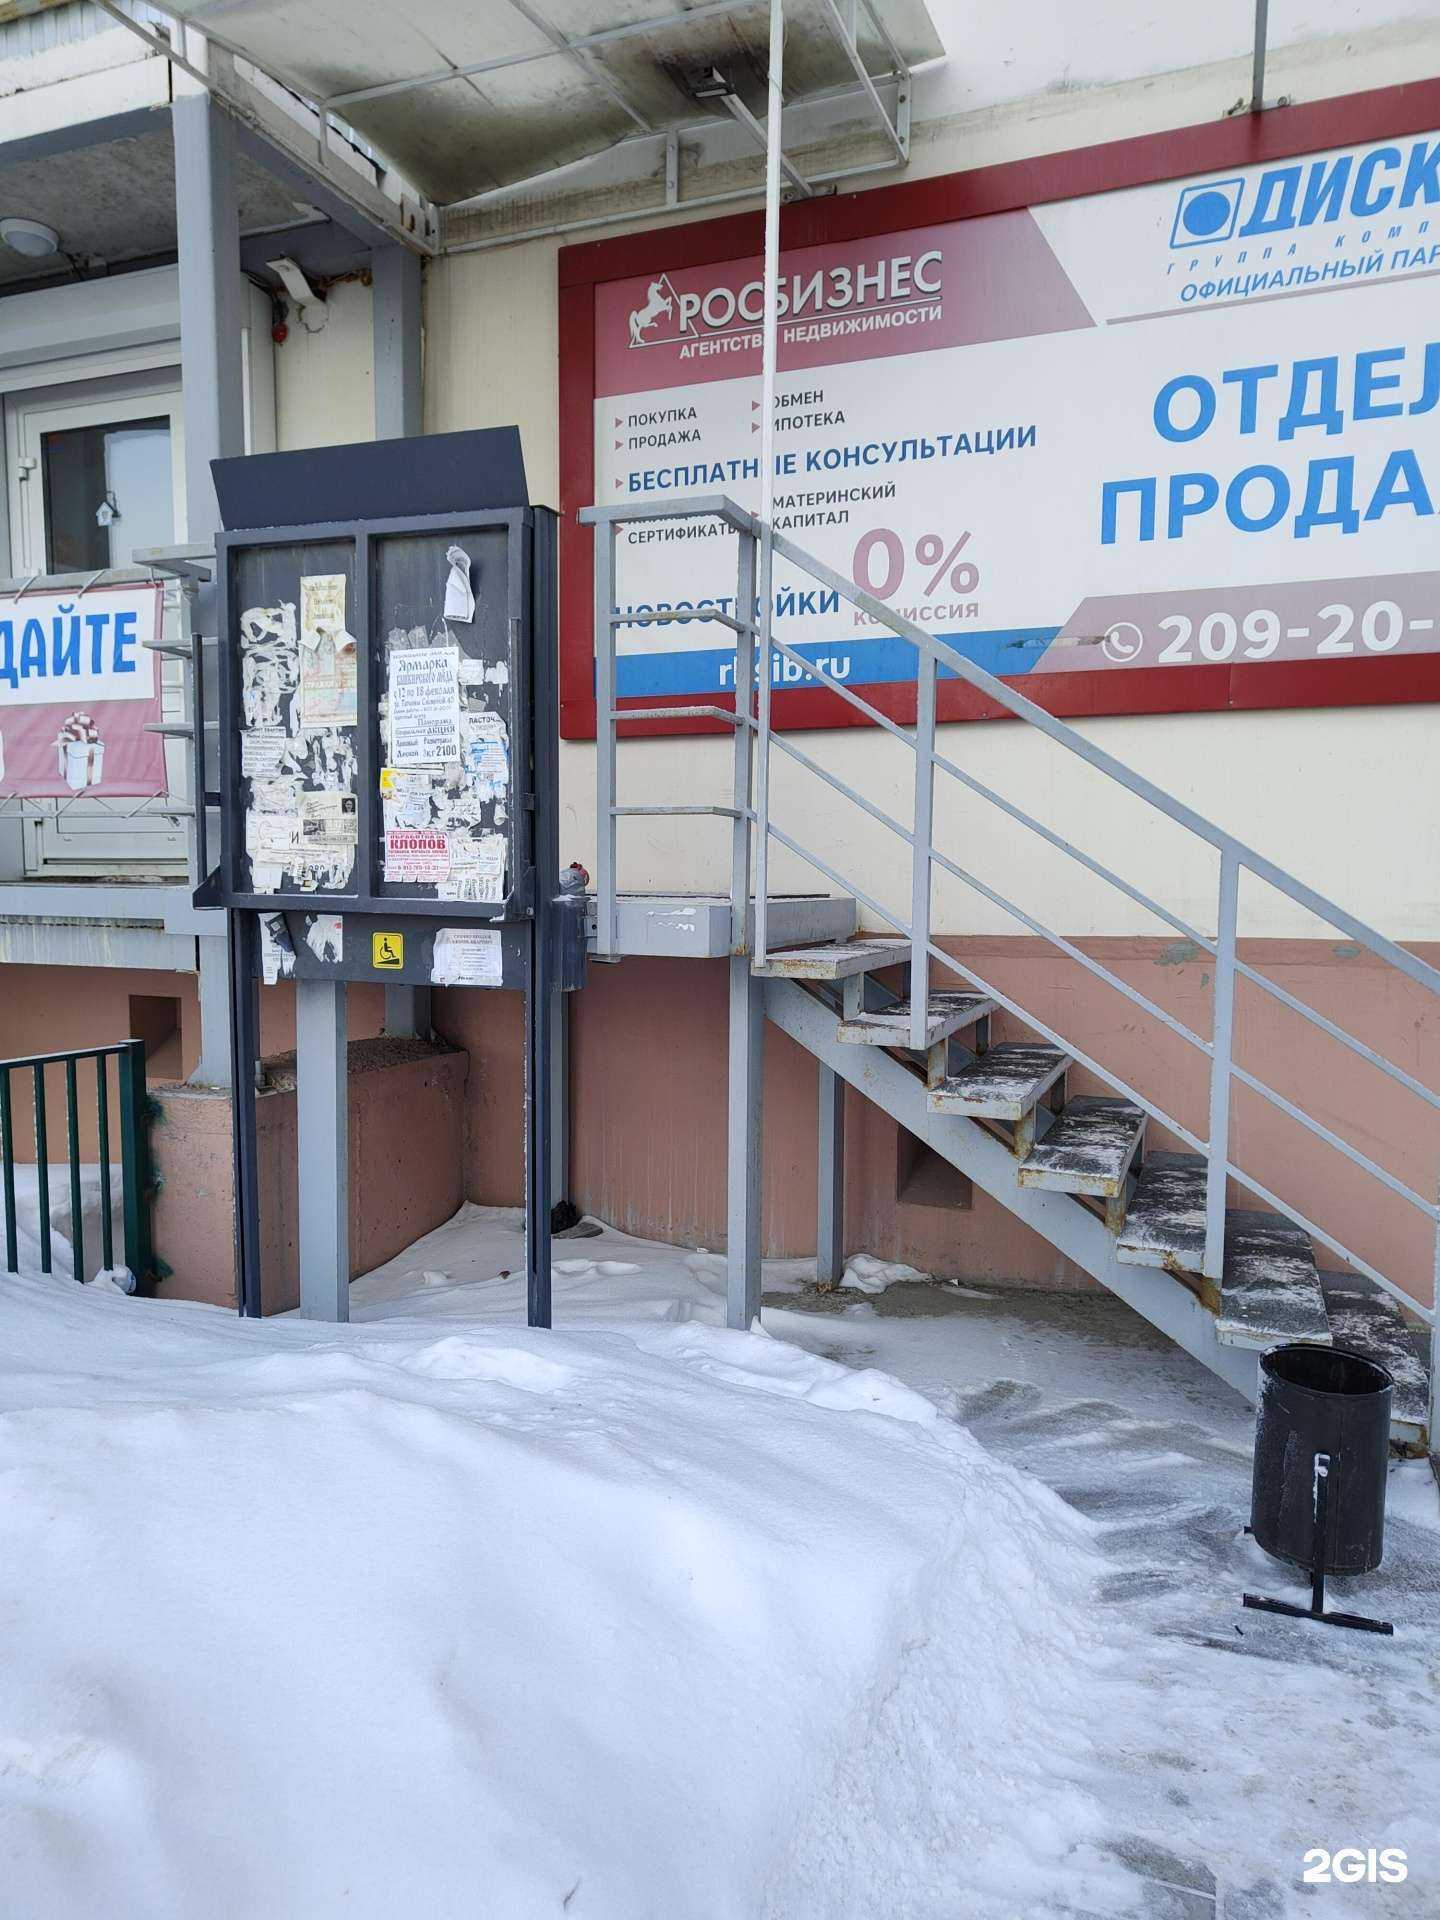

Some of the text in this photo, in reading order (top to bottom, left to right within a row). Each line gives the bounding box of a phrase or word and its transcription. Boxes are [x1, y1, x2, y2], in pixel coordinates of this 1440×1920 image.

[1166, 244, 1297, 275] ГРУППА
[1180, 249, 1386, 302] ОФИЦИАЛЬНЫЙ
[679, 304, 943, 360] АГЕНТСТВ НЕДВИЖИМОСТИ
[628, 406, 698, 428] ПОКУПКА
[628, 429, 702, 451] ПРОДАЖА
[806, 424, 1037, 472] КОНСУЛЬТАЦИИ
[772, 482, 897, 510] МАТЕРИНСКИЙ
[1101, 448, 1440, 545] ПРОДА
[772, 510, 849, 530] КАПИТАЛ
[852, 527, 980, 602] 0%
[614, 586, 840, 629] НОВОСТЙКИ
[436, 744, 457, 757] 2100
[390, 840, 446, 850] КЛОПОВ
